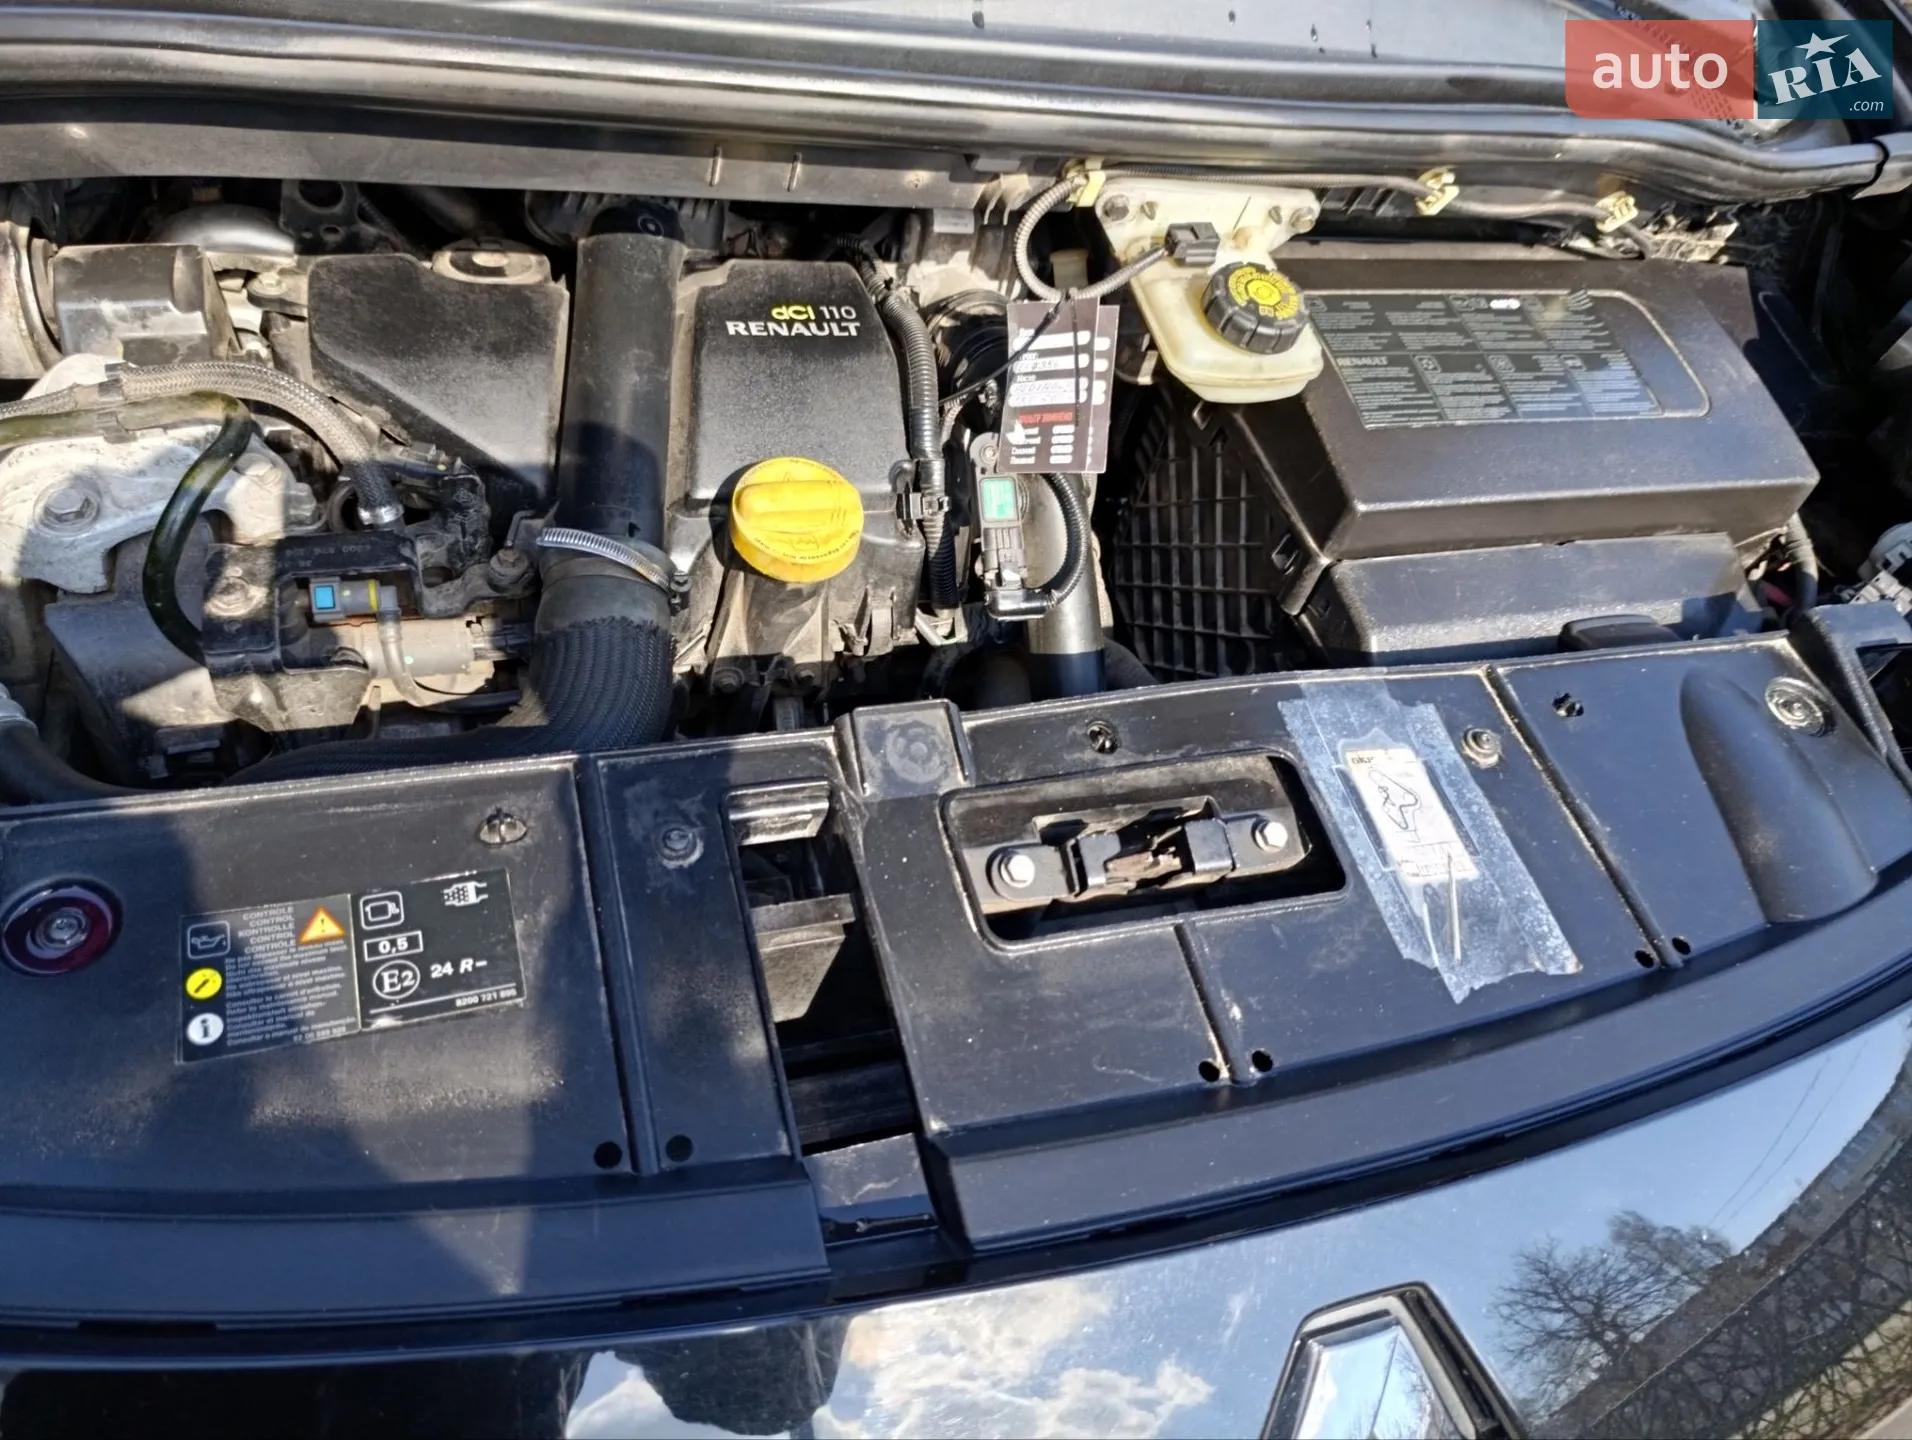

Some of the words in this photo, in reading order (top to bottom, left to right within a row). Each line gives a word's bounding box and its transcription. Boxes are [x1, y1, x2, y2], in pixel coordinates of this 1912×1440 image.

[819, 305, 857, 320] 110
[725, 320, 861, 337] RENAULT
[378, 936, 409, 954] 0,5
[430, 962, 454, 979] 24
[381, 969, 415, 993] E2
